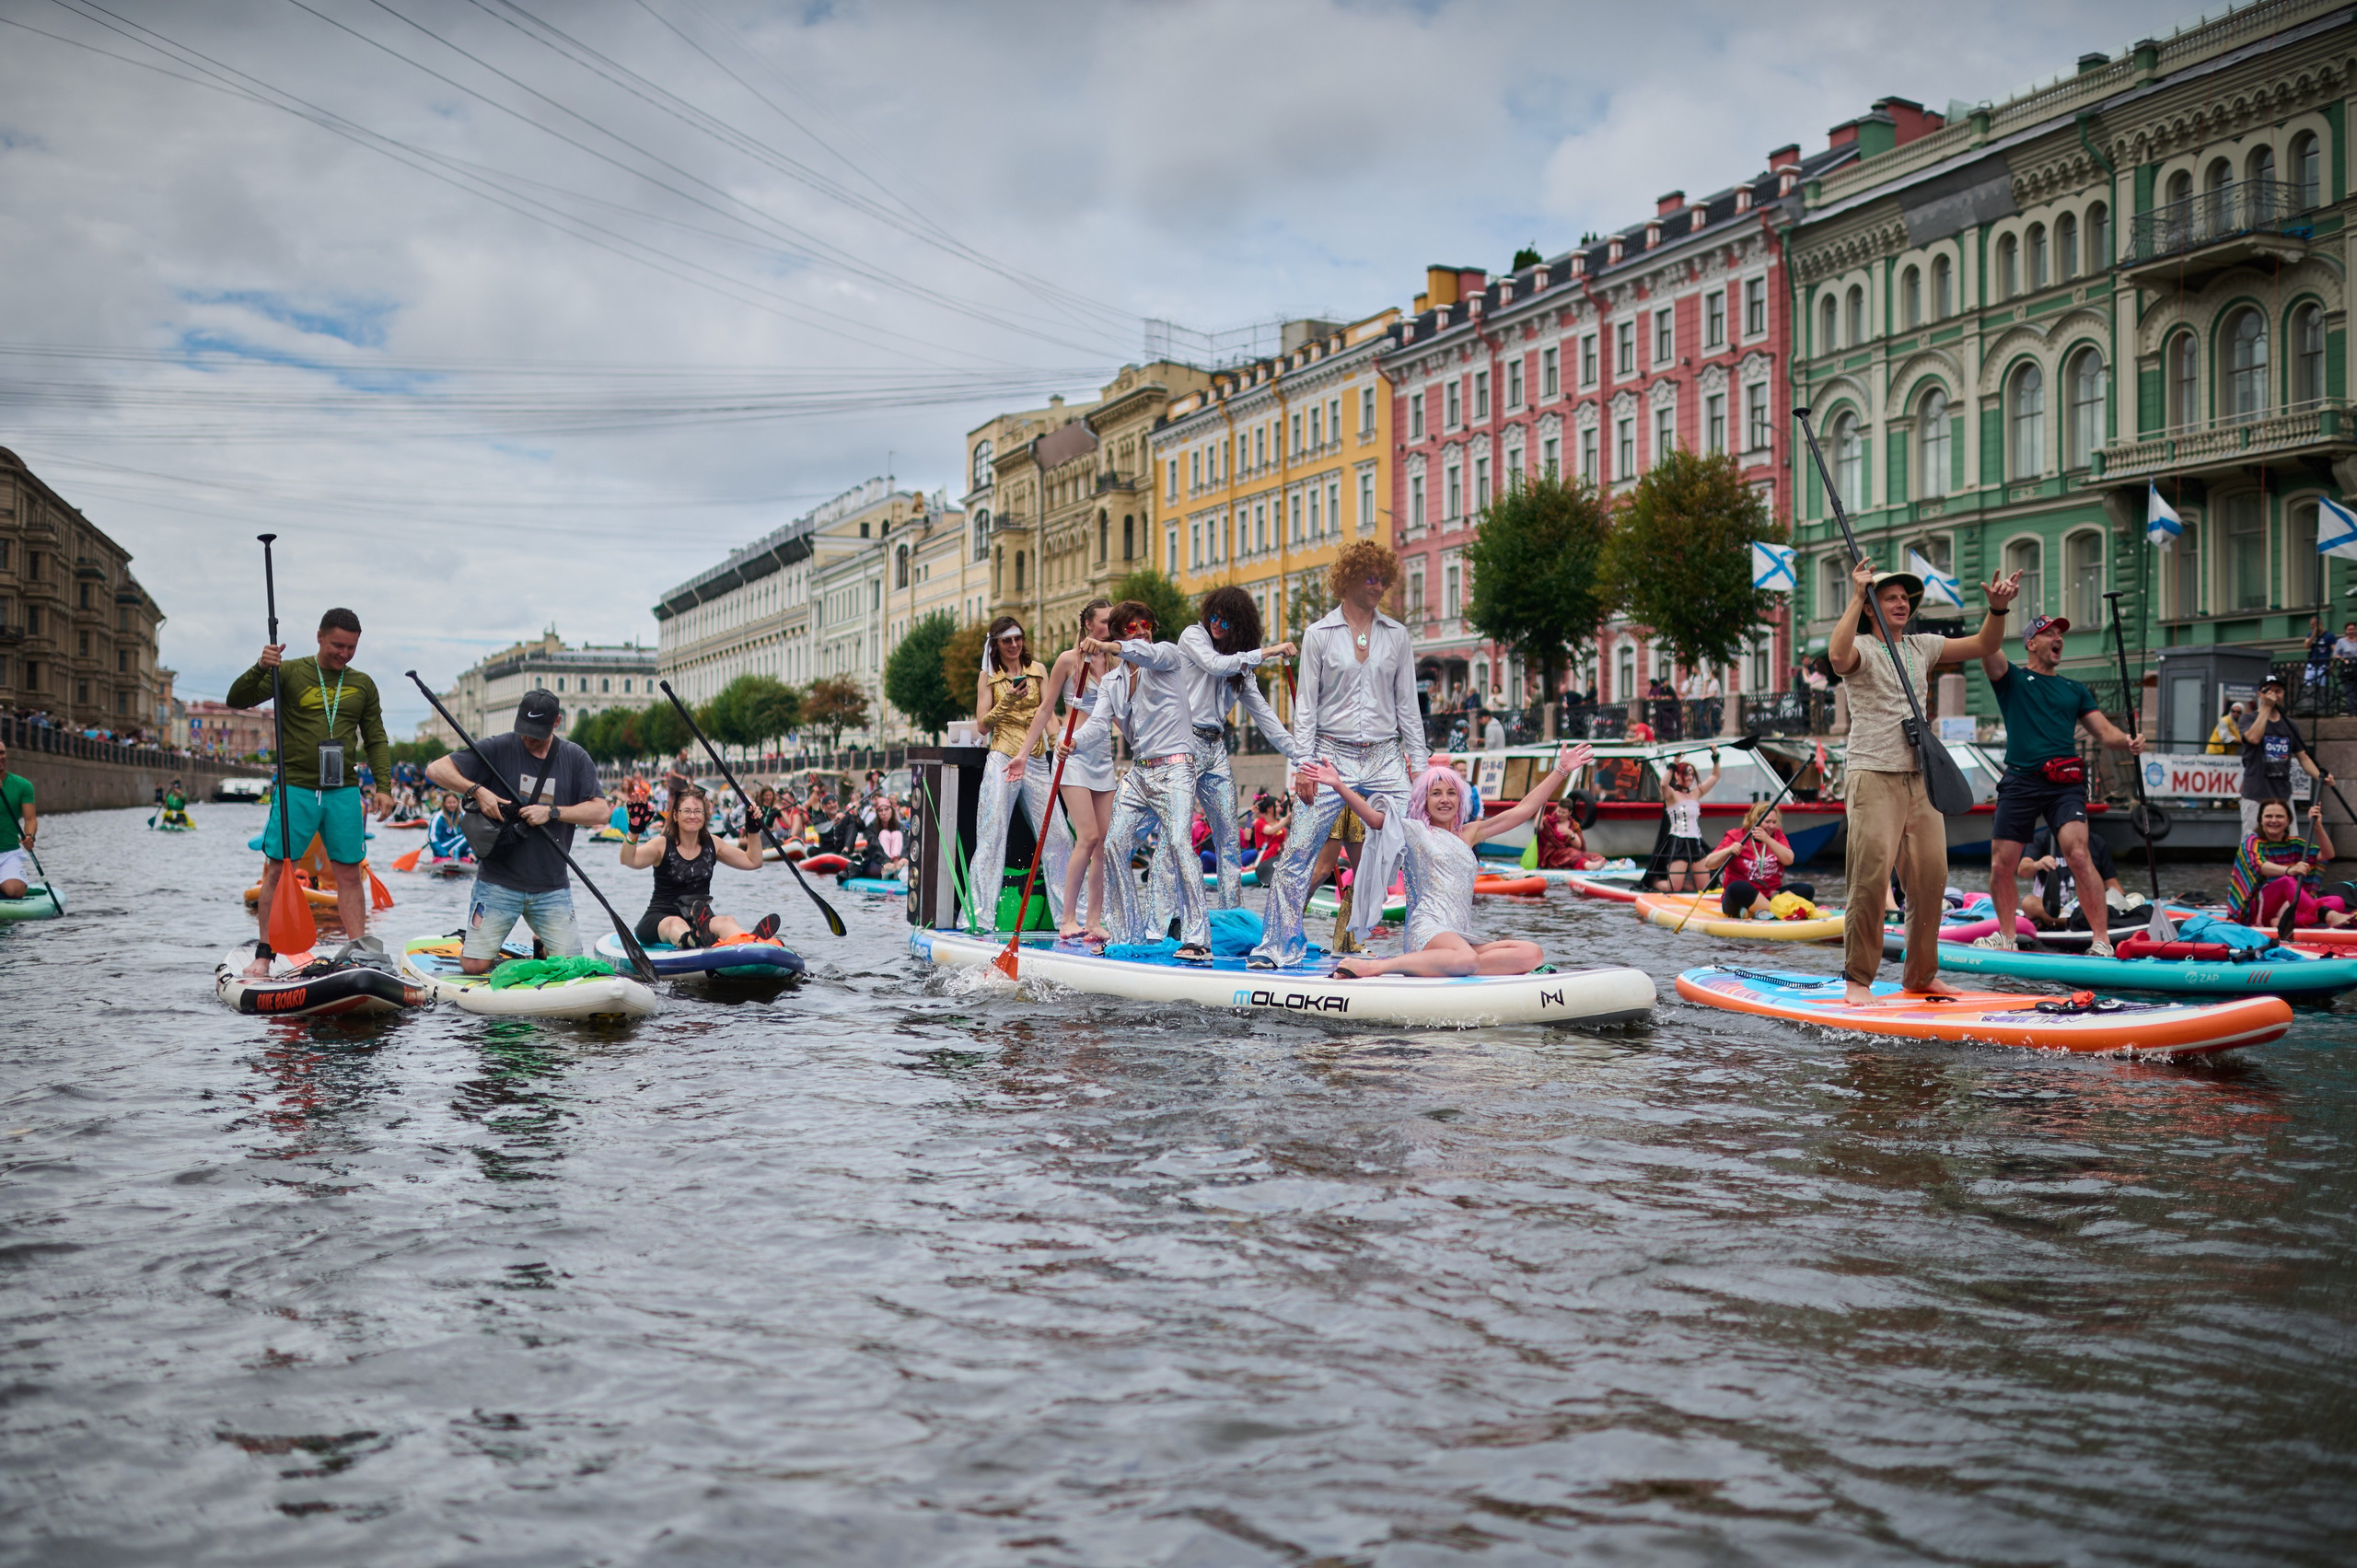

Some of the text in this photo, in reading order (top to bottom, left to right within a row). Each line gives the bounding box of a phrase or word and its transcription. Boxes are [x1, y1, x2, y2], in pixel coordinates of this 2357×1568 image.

[2266, 742, 2289, 753] 0470
[2200, 973, 2220, 982] ZAP
[257, 987, 307, 1011] RAVE BOARD
[1233, 990, 1350, 1013] MOLOKAI
